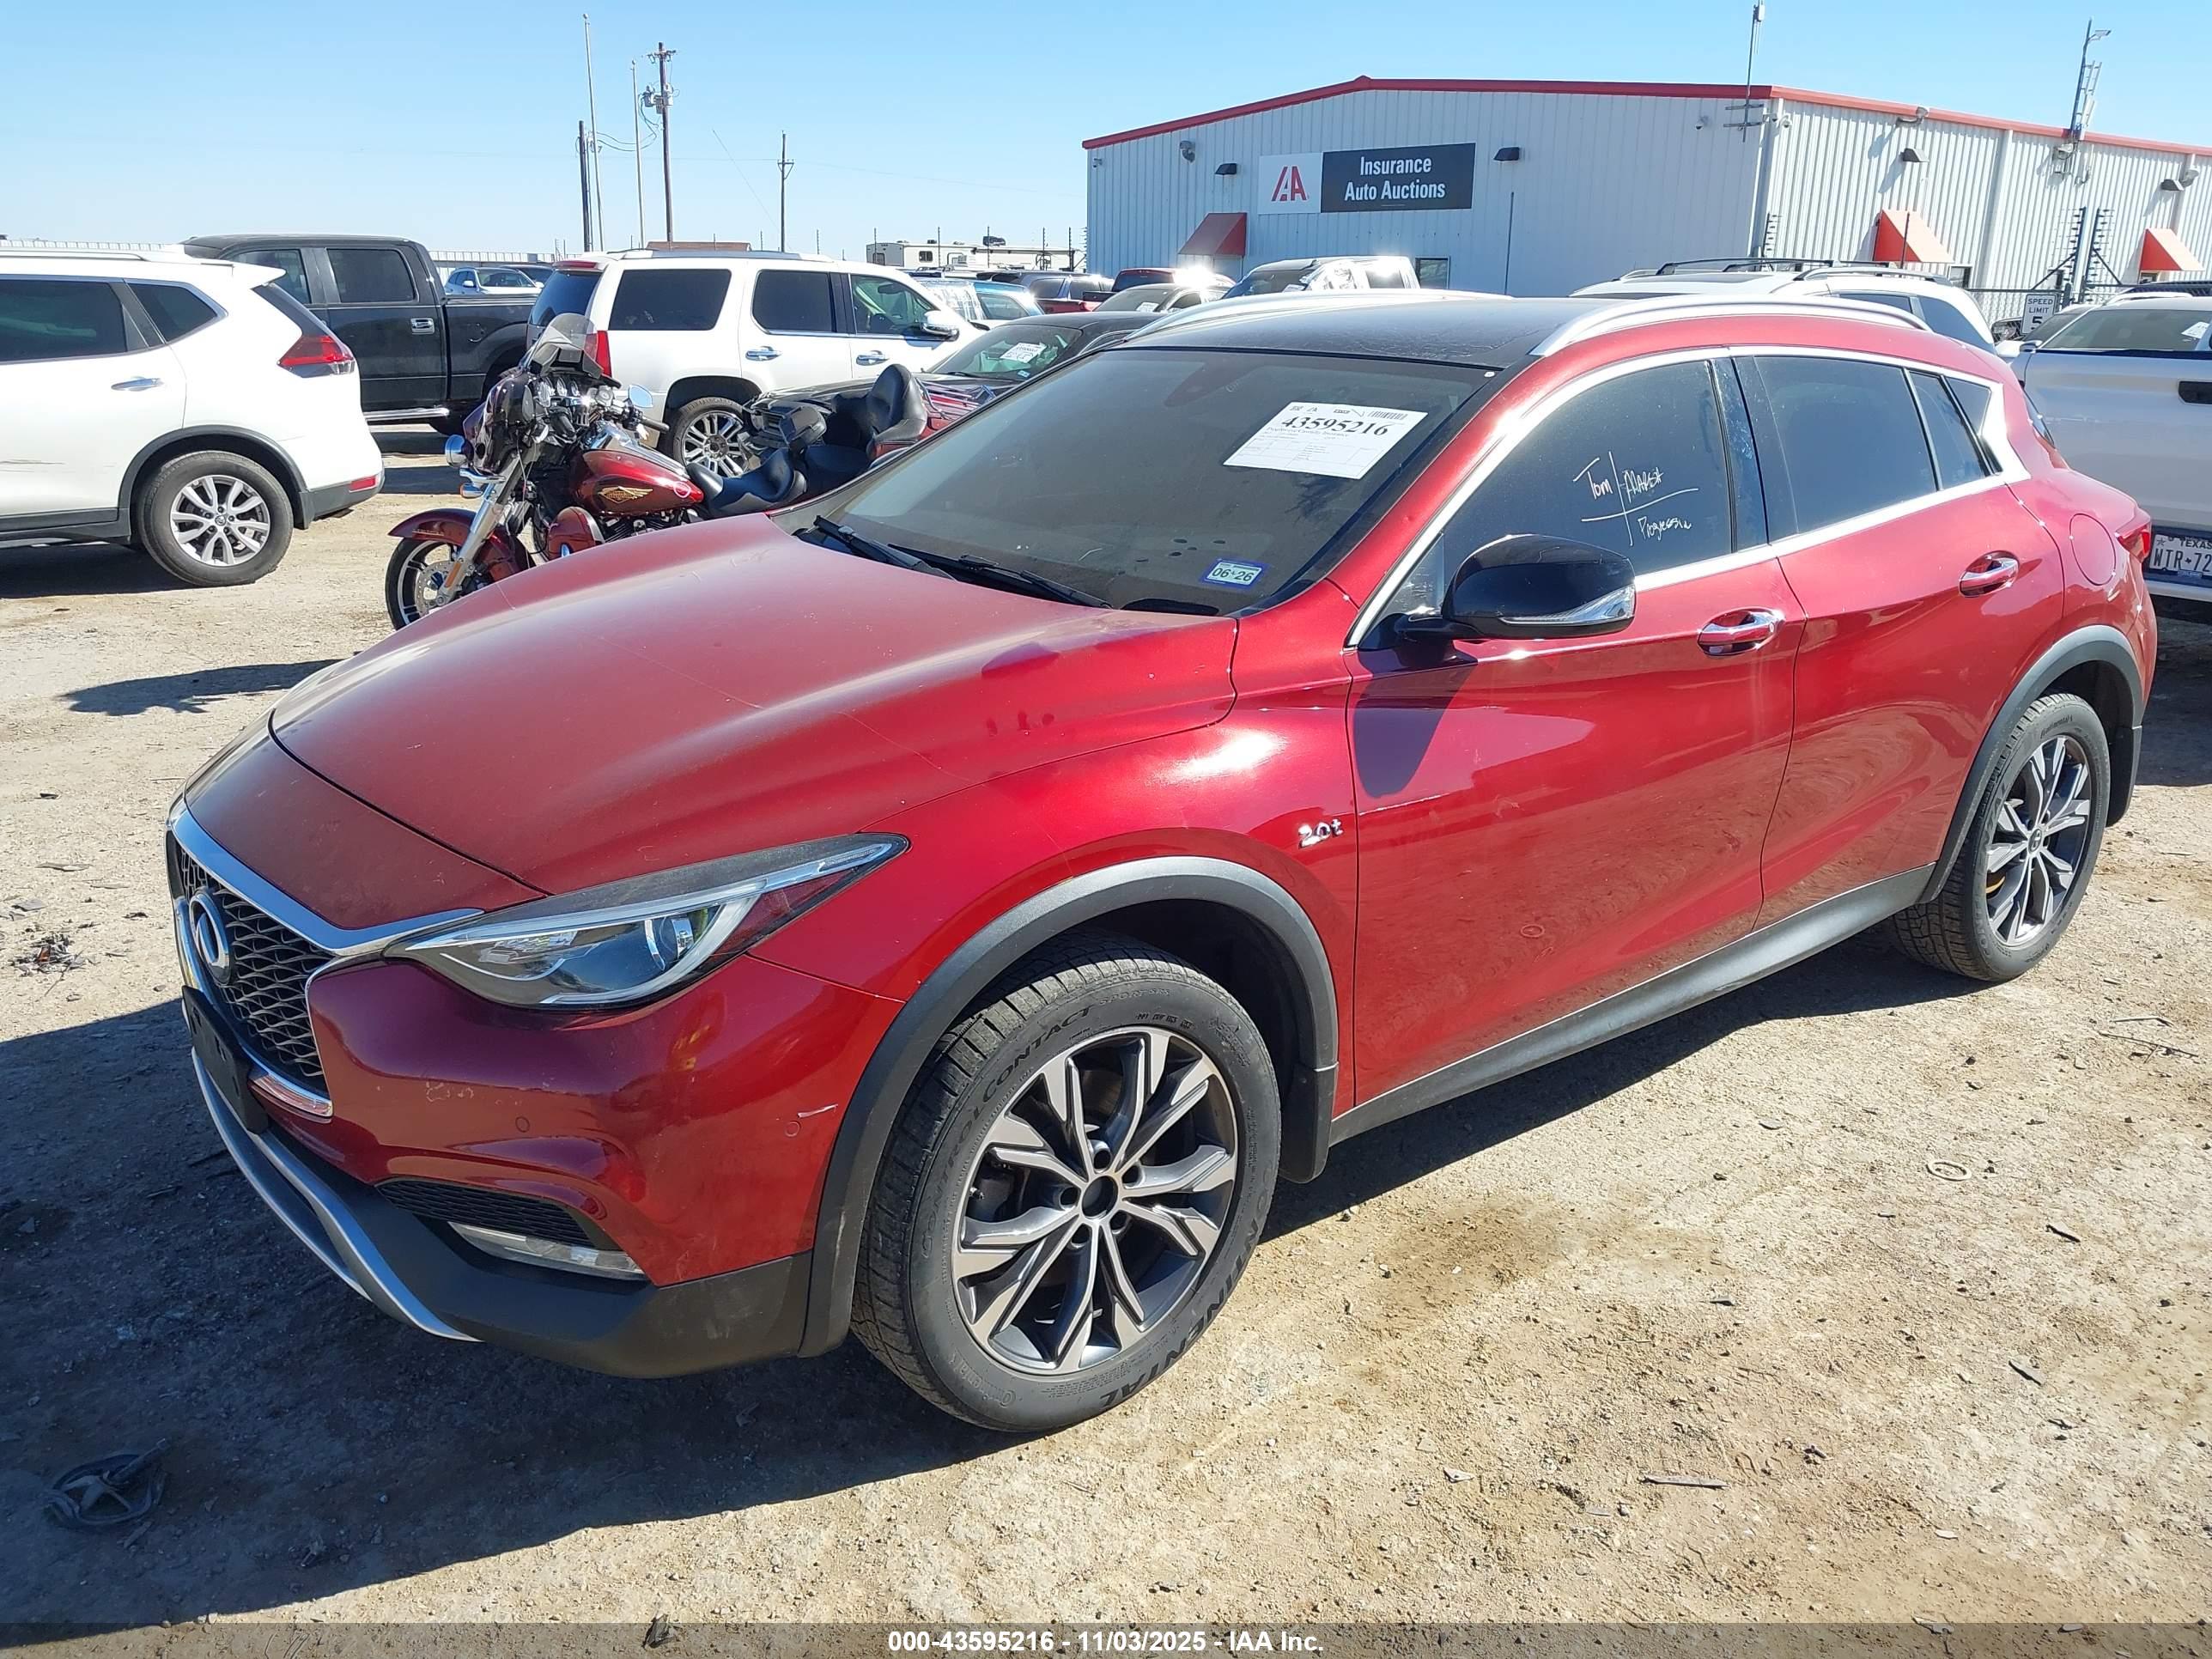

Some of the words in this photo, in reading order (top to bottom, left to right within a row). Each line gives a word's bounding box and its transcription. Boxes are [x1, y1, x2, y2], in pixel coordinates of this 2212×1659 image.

[1359, 155, 1433, 175] Insurance
[1344, 180, 1377, 201] Auto
[1381, 179, 1446, 200] Auctions
[2031, 316, 2043, 330] 5
[1282, 416, 1397, 436] 43595216
